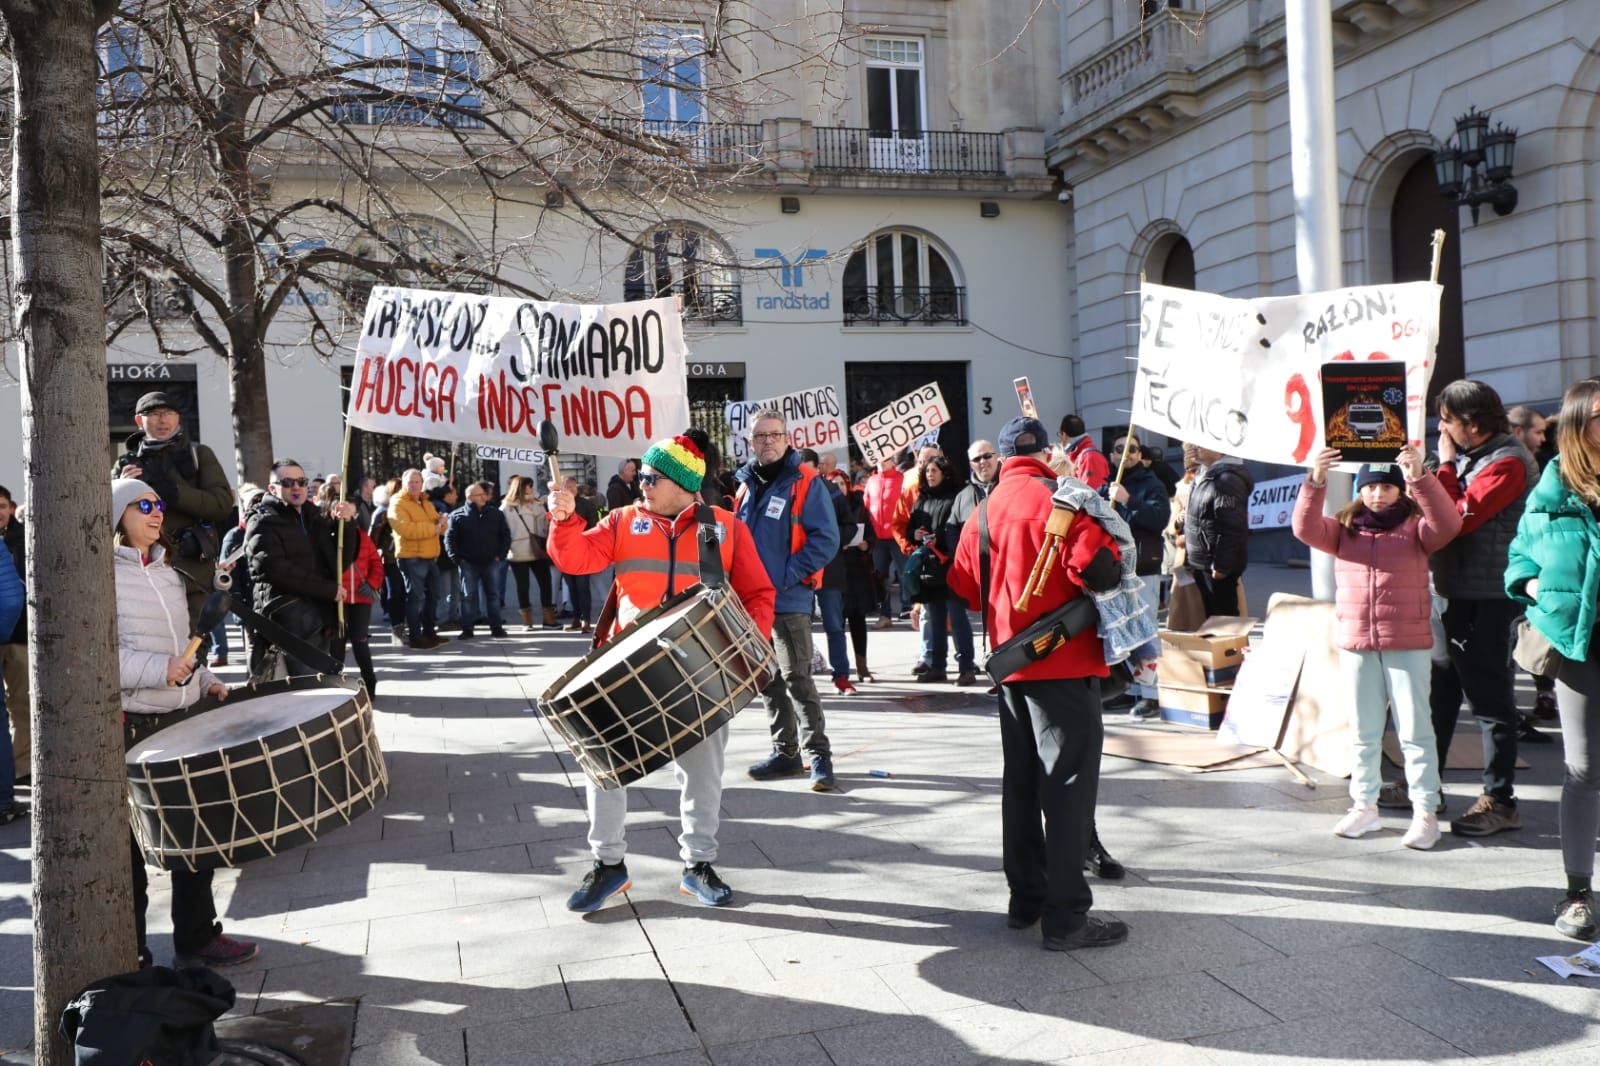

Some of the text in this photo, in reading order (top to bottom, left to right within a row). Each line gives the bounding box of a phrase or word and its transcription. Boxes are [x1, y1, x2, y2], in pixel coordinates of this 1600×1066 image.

[757, 291, 830, 310] randstad
[1141, 294, 1183, 349] SE
[1392, 316, 1428, 340] DG
[106, 366, 171, 379] HORA
[686, 364, 727, 376] ORA
[355, 353, 652, 440] HUELGA INDEFINIDA
[730, 386, 840, 431] AMANCIAS
[982, 397, 992, 415] 3
[856, 386, 937, 437] acciona
[788, 420, 840, 450] ELGA
[476, 446, 543, 463] COMPLICES
[862, 440, 878, 465] NOS
[1251, 483, 1302, 507] SANITA
